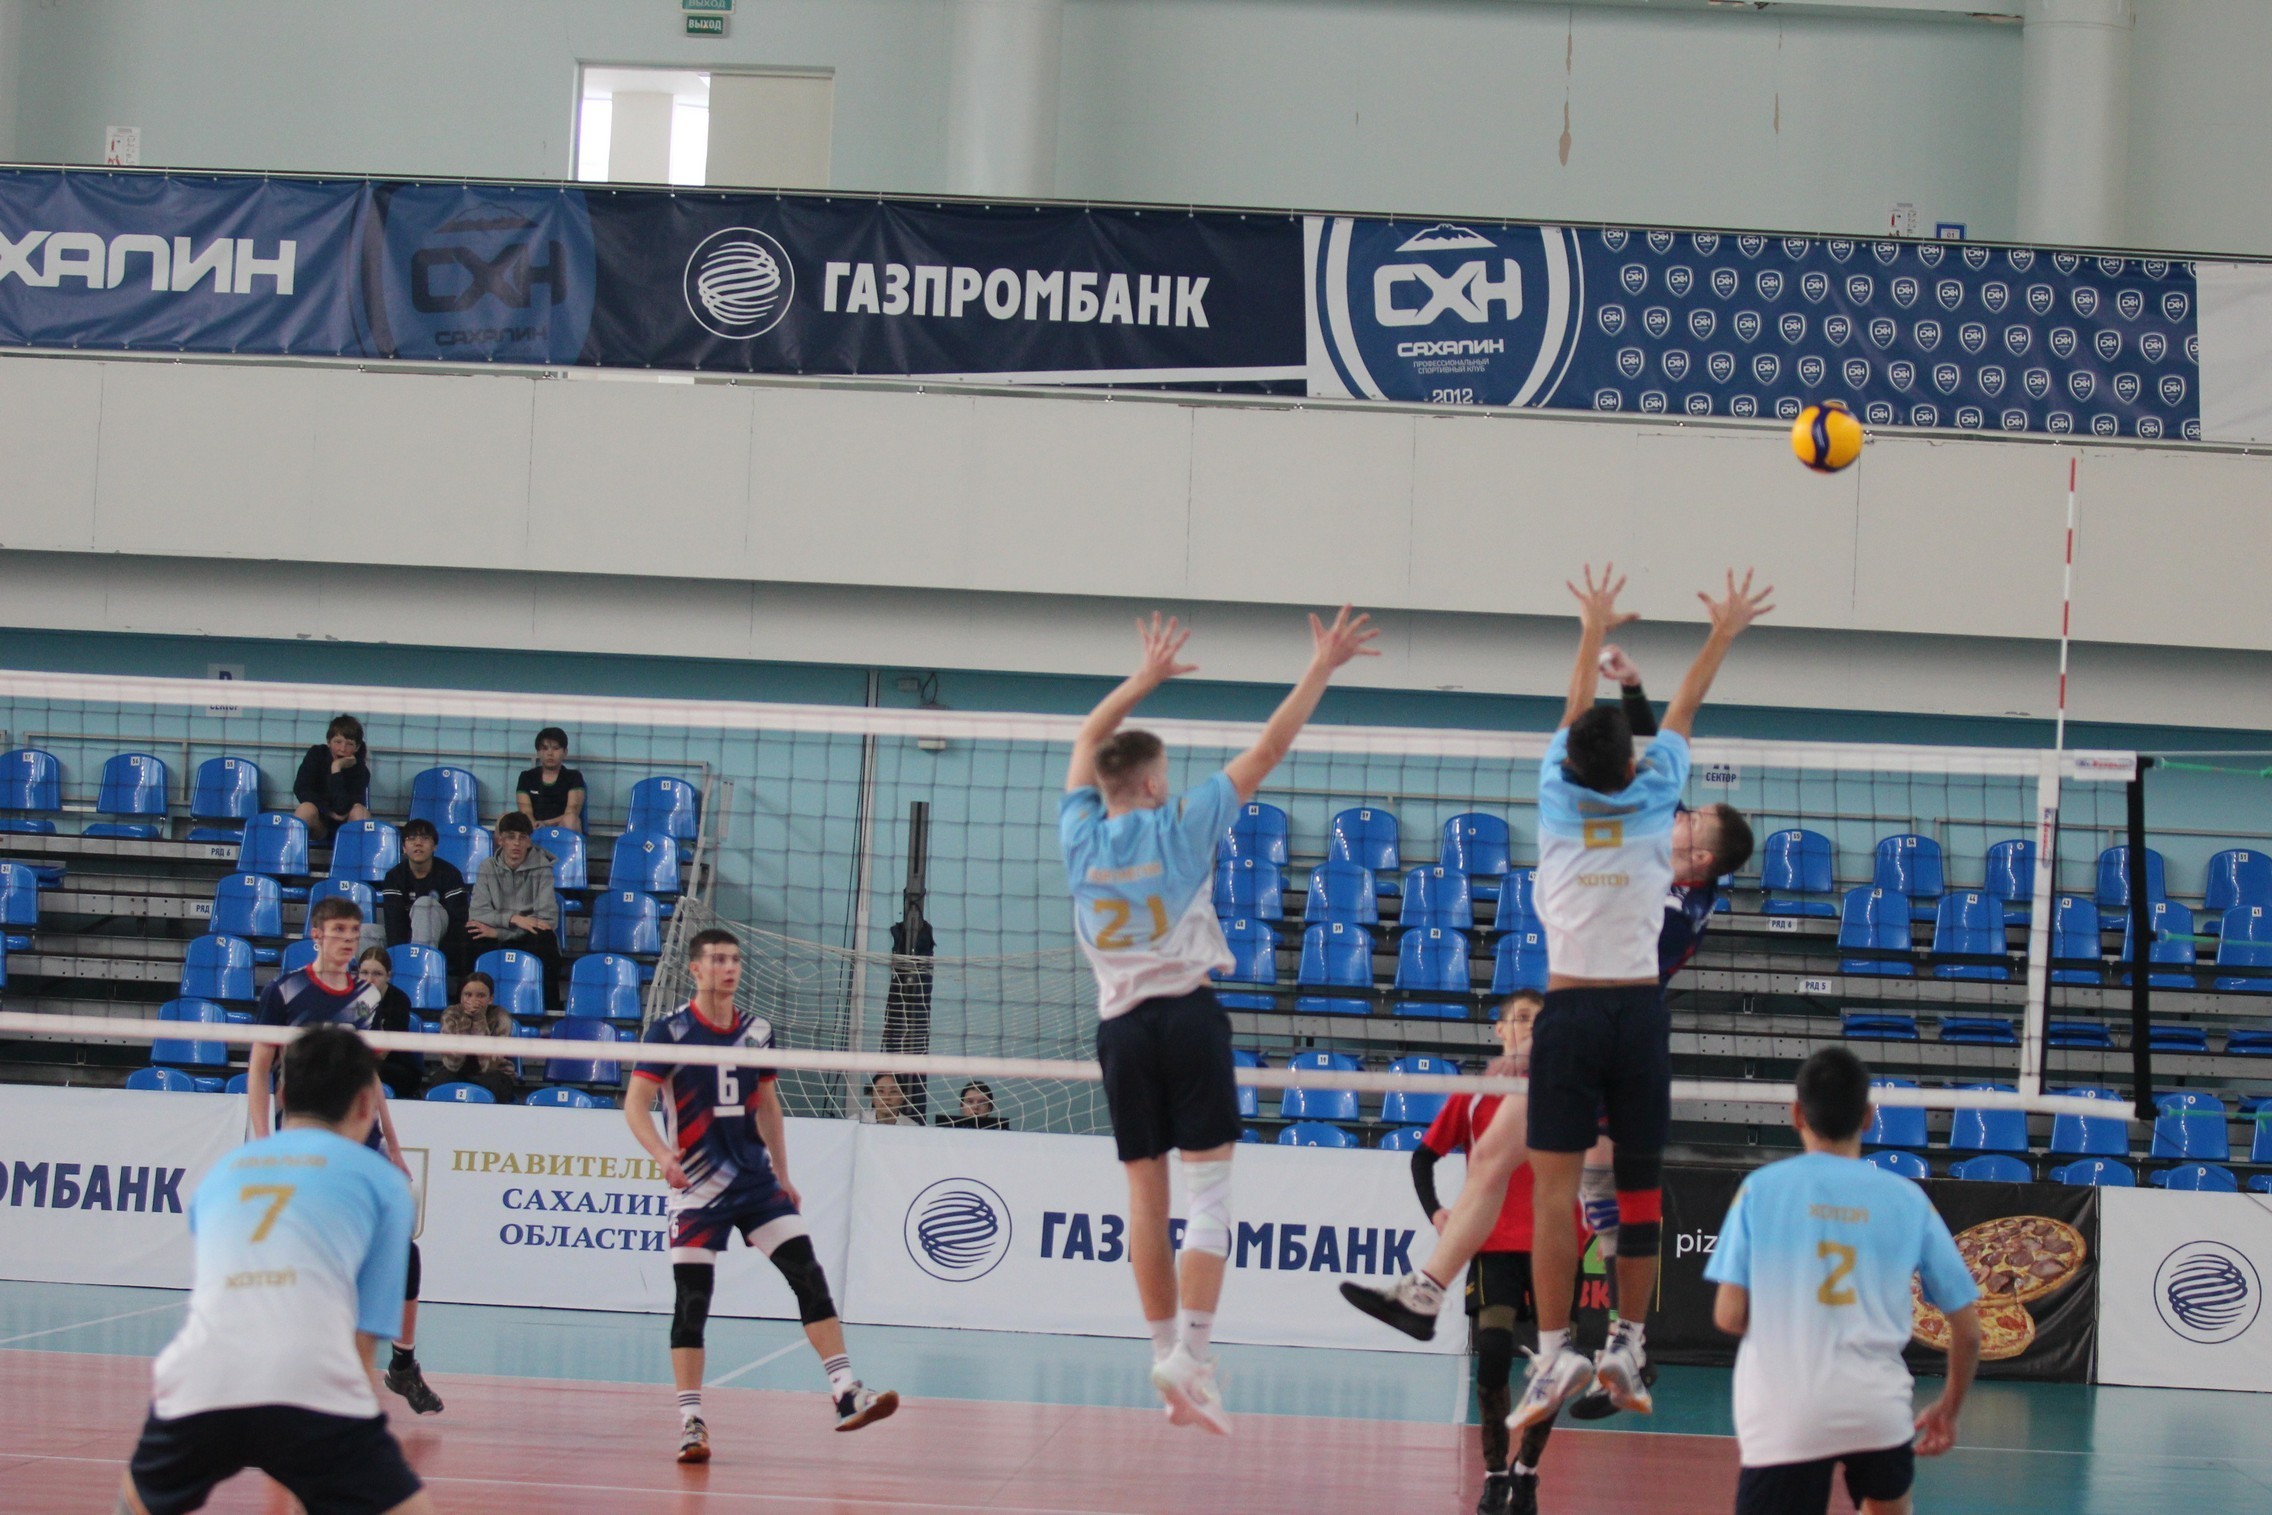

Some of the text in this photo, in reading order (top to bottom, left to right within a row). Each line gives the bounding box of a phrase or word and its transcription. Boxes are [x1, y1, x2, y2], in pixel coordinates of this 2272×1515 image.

[688, 19, 722, 31] ВЫХОД
[823, 261, 1210, 329] ГАЗПРОМБАНК
[1397, 338, 1504, 357] САХАЛИН
[1412, 357, 1490, 368] ПРОФЕССИОНАЛЬНЫЙ
[1418, 363, 1486, 375] СПОРТИВНЫЙ КЛУБ
[1432, 388, 1473, 404] 2012
[1705, 771, 1737, 783] СЕКТОР
[210, 847, 225, 857] РЯД
[195, 904, 210, 914] РЯД
[1094, 895, 1168, 950] 21
[1771, 920, 1786, 929] РЯД
[1805, 980, 1820, 991] РЯД
[718, 1064, 740, 1105] 6
[239, 1184, 297, 1242] 7
[499, 1222, 667, 1252] ОБЛАСТИ
[1040, 1211, 1416, 1277] ГАЗРМБАНК
[1816, 1240, 1857, 1307] 2
